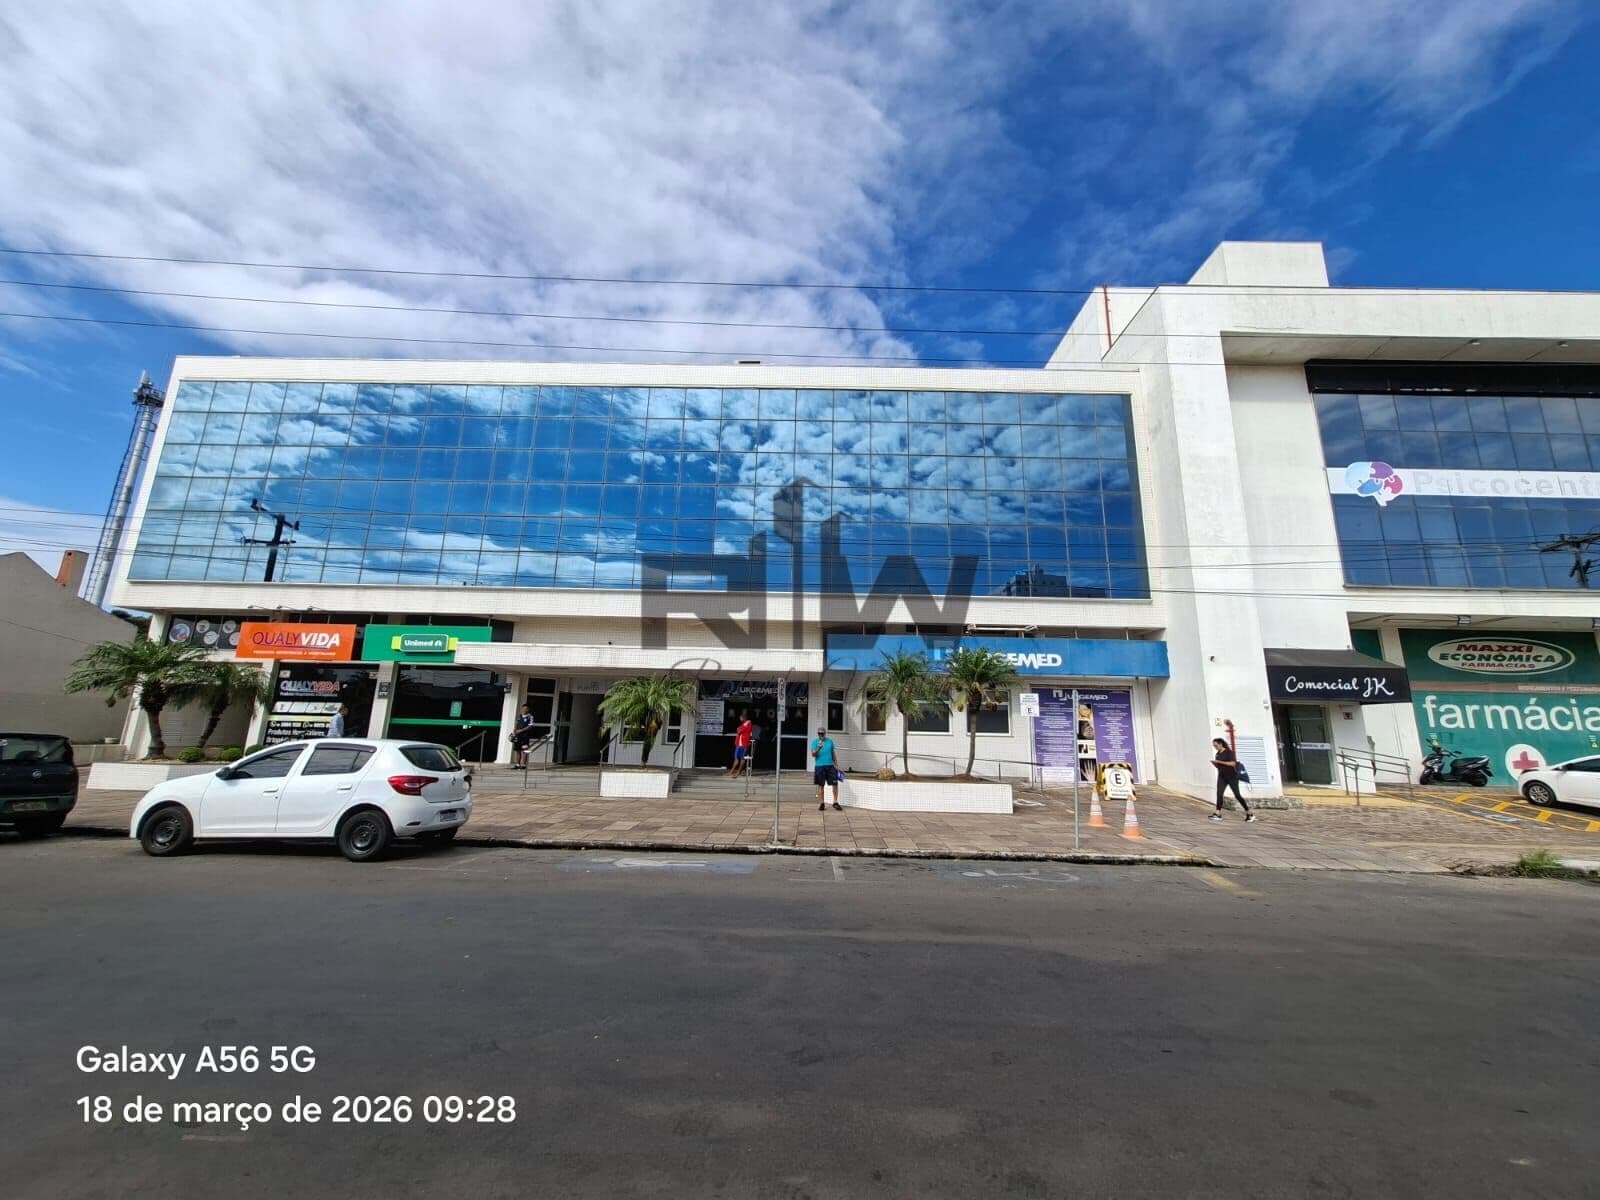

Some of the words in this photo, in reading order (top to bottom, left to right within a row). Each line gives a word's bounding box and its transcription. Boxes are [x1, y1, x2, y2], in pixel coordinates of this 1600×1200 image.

[252, 631, 340, 649] QUALYVIDA
[404, 639, 434, 647] Unimed
[1456, 643, 1534, 653] MAXXI
[280, 680, 340, 692] QUALYVIDA
[1285, 676, 1360, 693] Comercial
[1362, 677, 1395, 698] JK
[1422, 695, 1600, 732] farmácia
[1114, 773, 1122, 784] E
